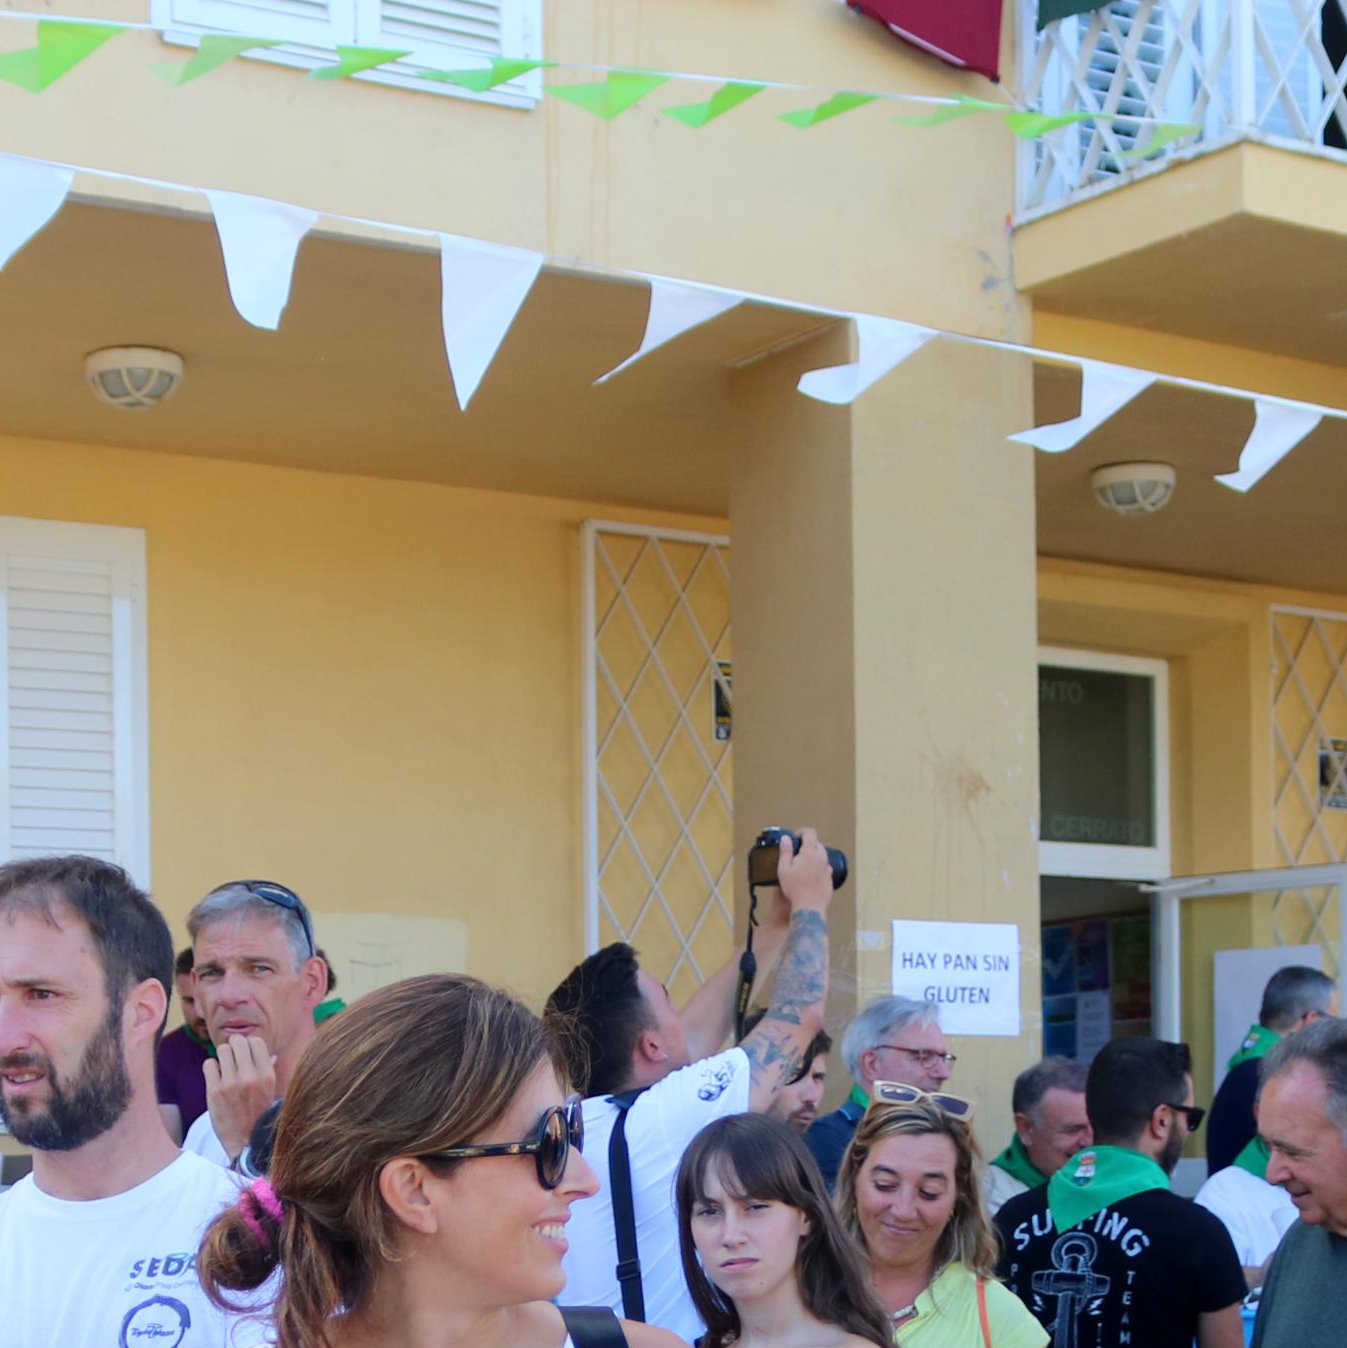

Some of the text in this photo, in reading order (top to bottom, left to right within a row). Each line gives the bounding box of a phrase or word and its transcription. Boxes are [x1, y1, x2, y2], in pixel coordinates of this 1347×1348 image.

[1051, 816, 1145, 841] CERRATO
[902, 952, 1010, 972] HAY PAN SIN
[924, 985, 990, 1004] GLUTEN
[1013, 1208, 1150, 1257] SUING
[1119, 1271, 1135, 1345] TEAM
